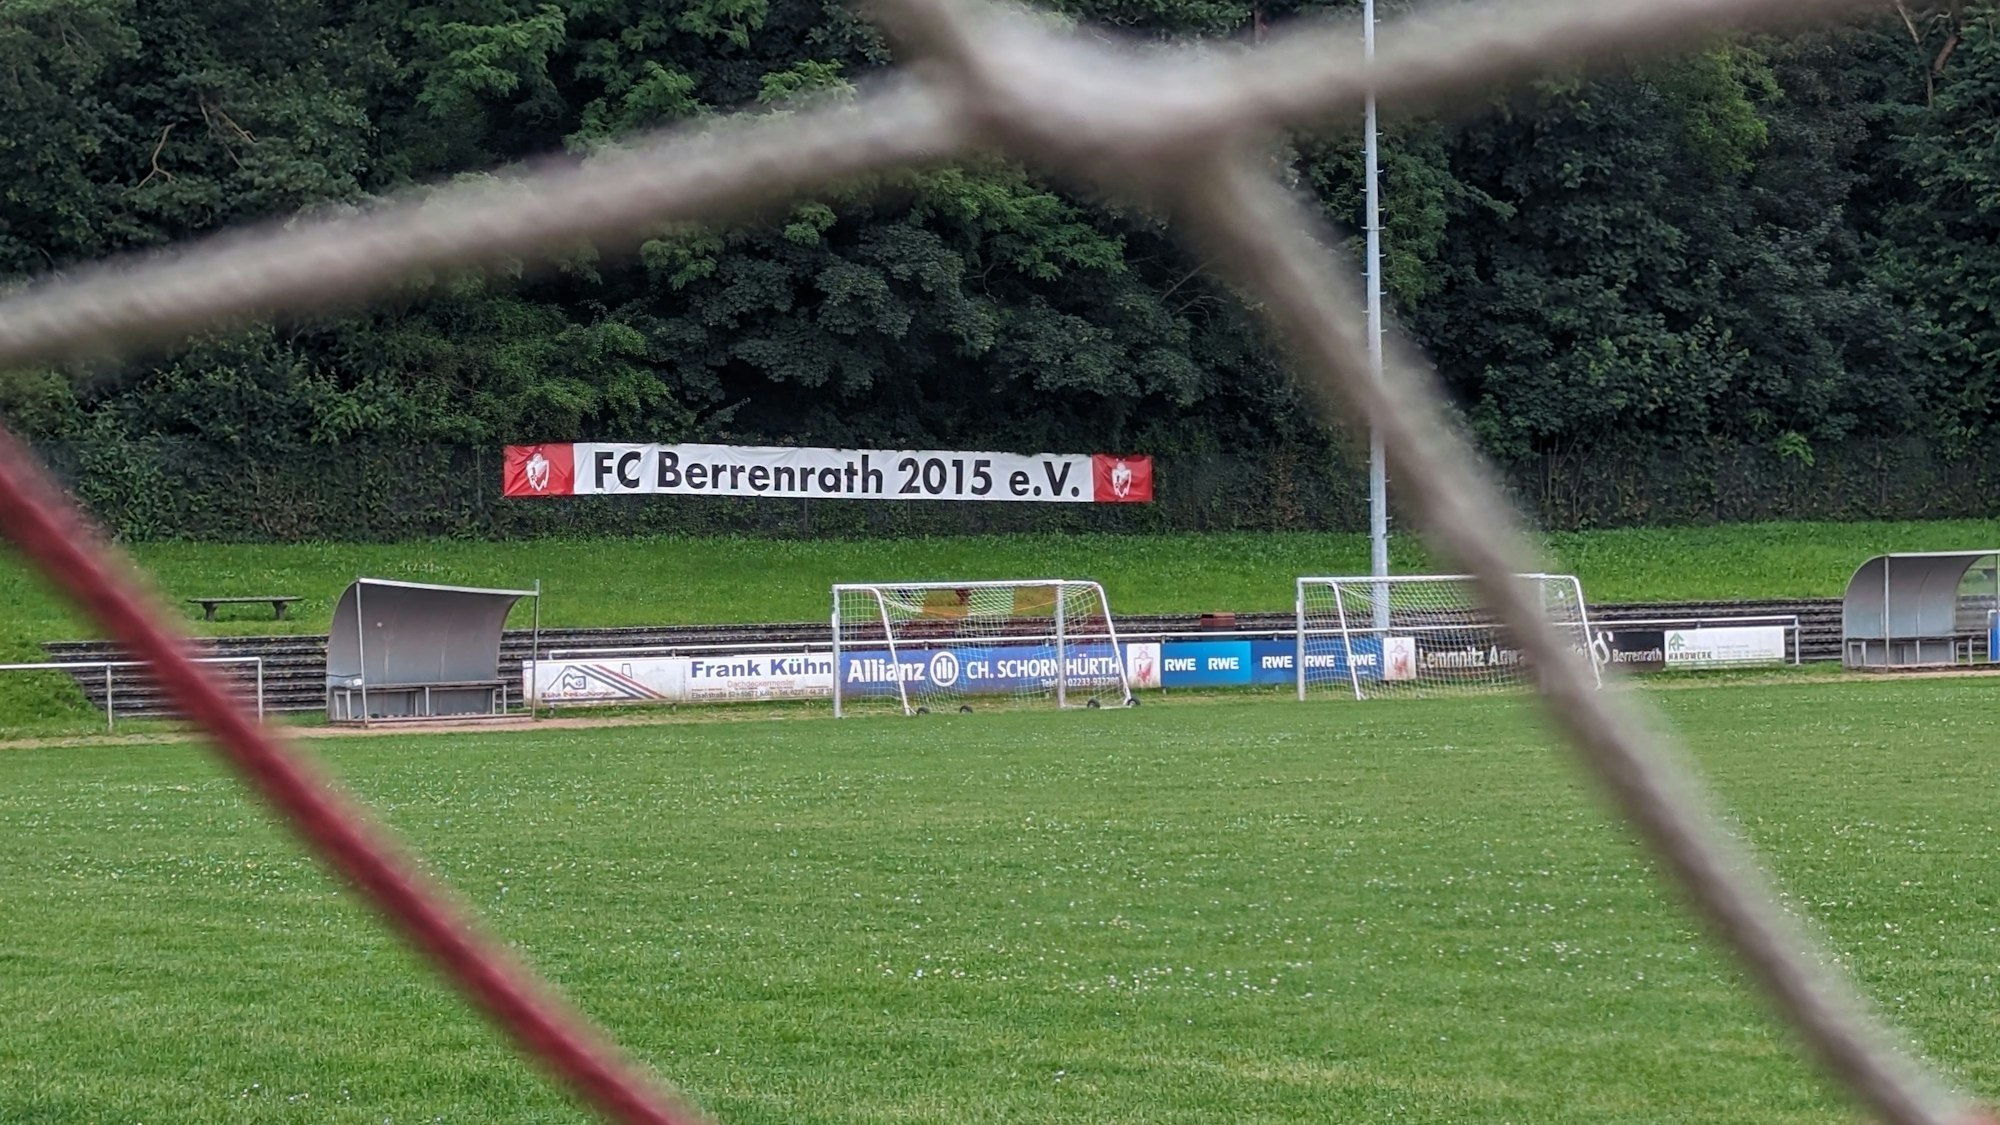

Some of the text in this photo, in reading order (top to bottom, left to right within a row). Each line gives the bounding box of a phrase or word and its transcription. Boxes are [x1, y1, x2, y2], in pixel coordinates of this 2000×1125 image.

[595, 450, 1080, 497] FC Berrenrath 2015 e.V.
[1164, 656, 1240, 671] RWE RWE
[1262, 655, 1293, 669] RWE
[1304, 655, 1336, 668] RWE
[1612, 647, 1663, 663] Berrenrath
[1668, 651, 1713, 661] HANDWERK
[691, 658, 832, 678] Frank Kühn
[847, 659, 926, 683] Allianz
[966, 660, 995, 680] CH.
[1066, 653, 1120, 675] HÜRTH
